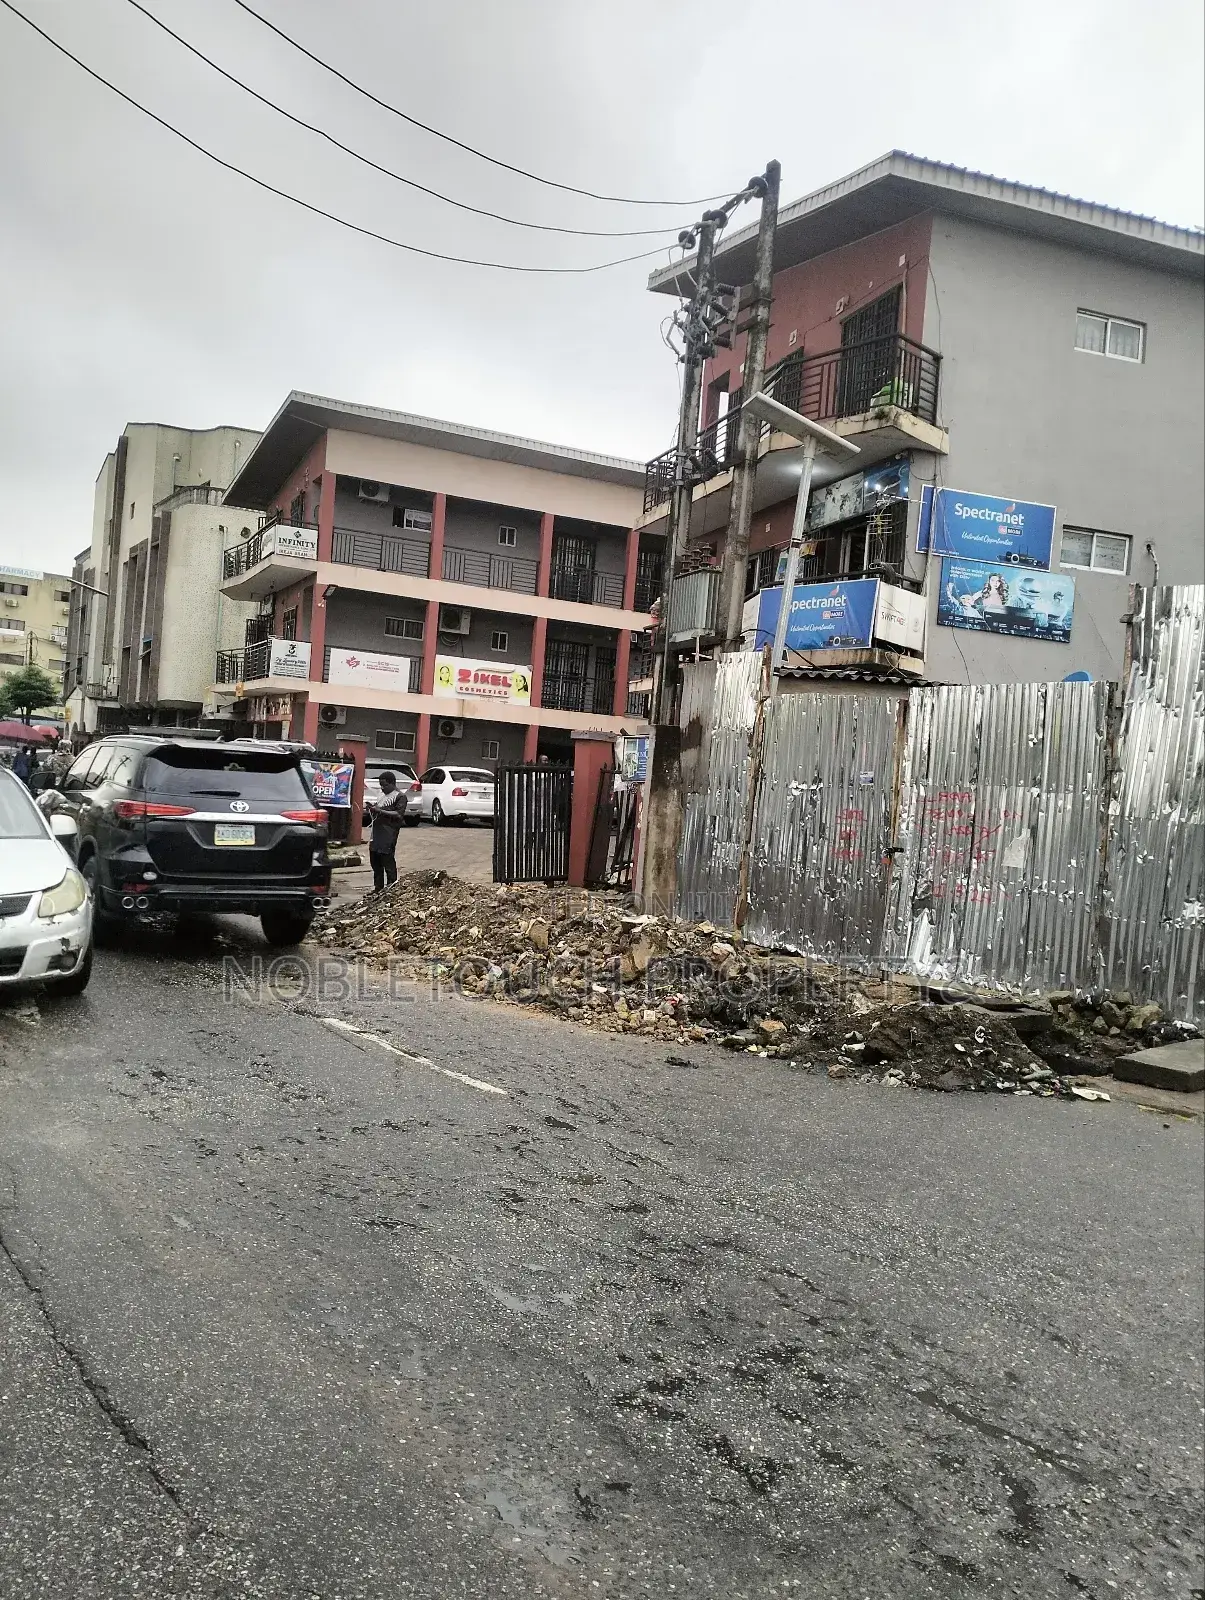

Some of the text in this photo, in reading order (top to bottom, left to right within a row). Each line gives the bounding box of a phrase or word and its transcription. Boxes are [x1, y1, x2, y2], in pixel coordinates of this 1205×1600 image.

[954, 502, 1025, 526] Spectranet
[278, 537, 316, 549] INFINITY
[789, 594, 847, 613] pectranet
[458, 668, 512, 688] ZIKEL
[459, 686, 508, 696] COSMETICS
[312, 785, 335, 796] OPEN
